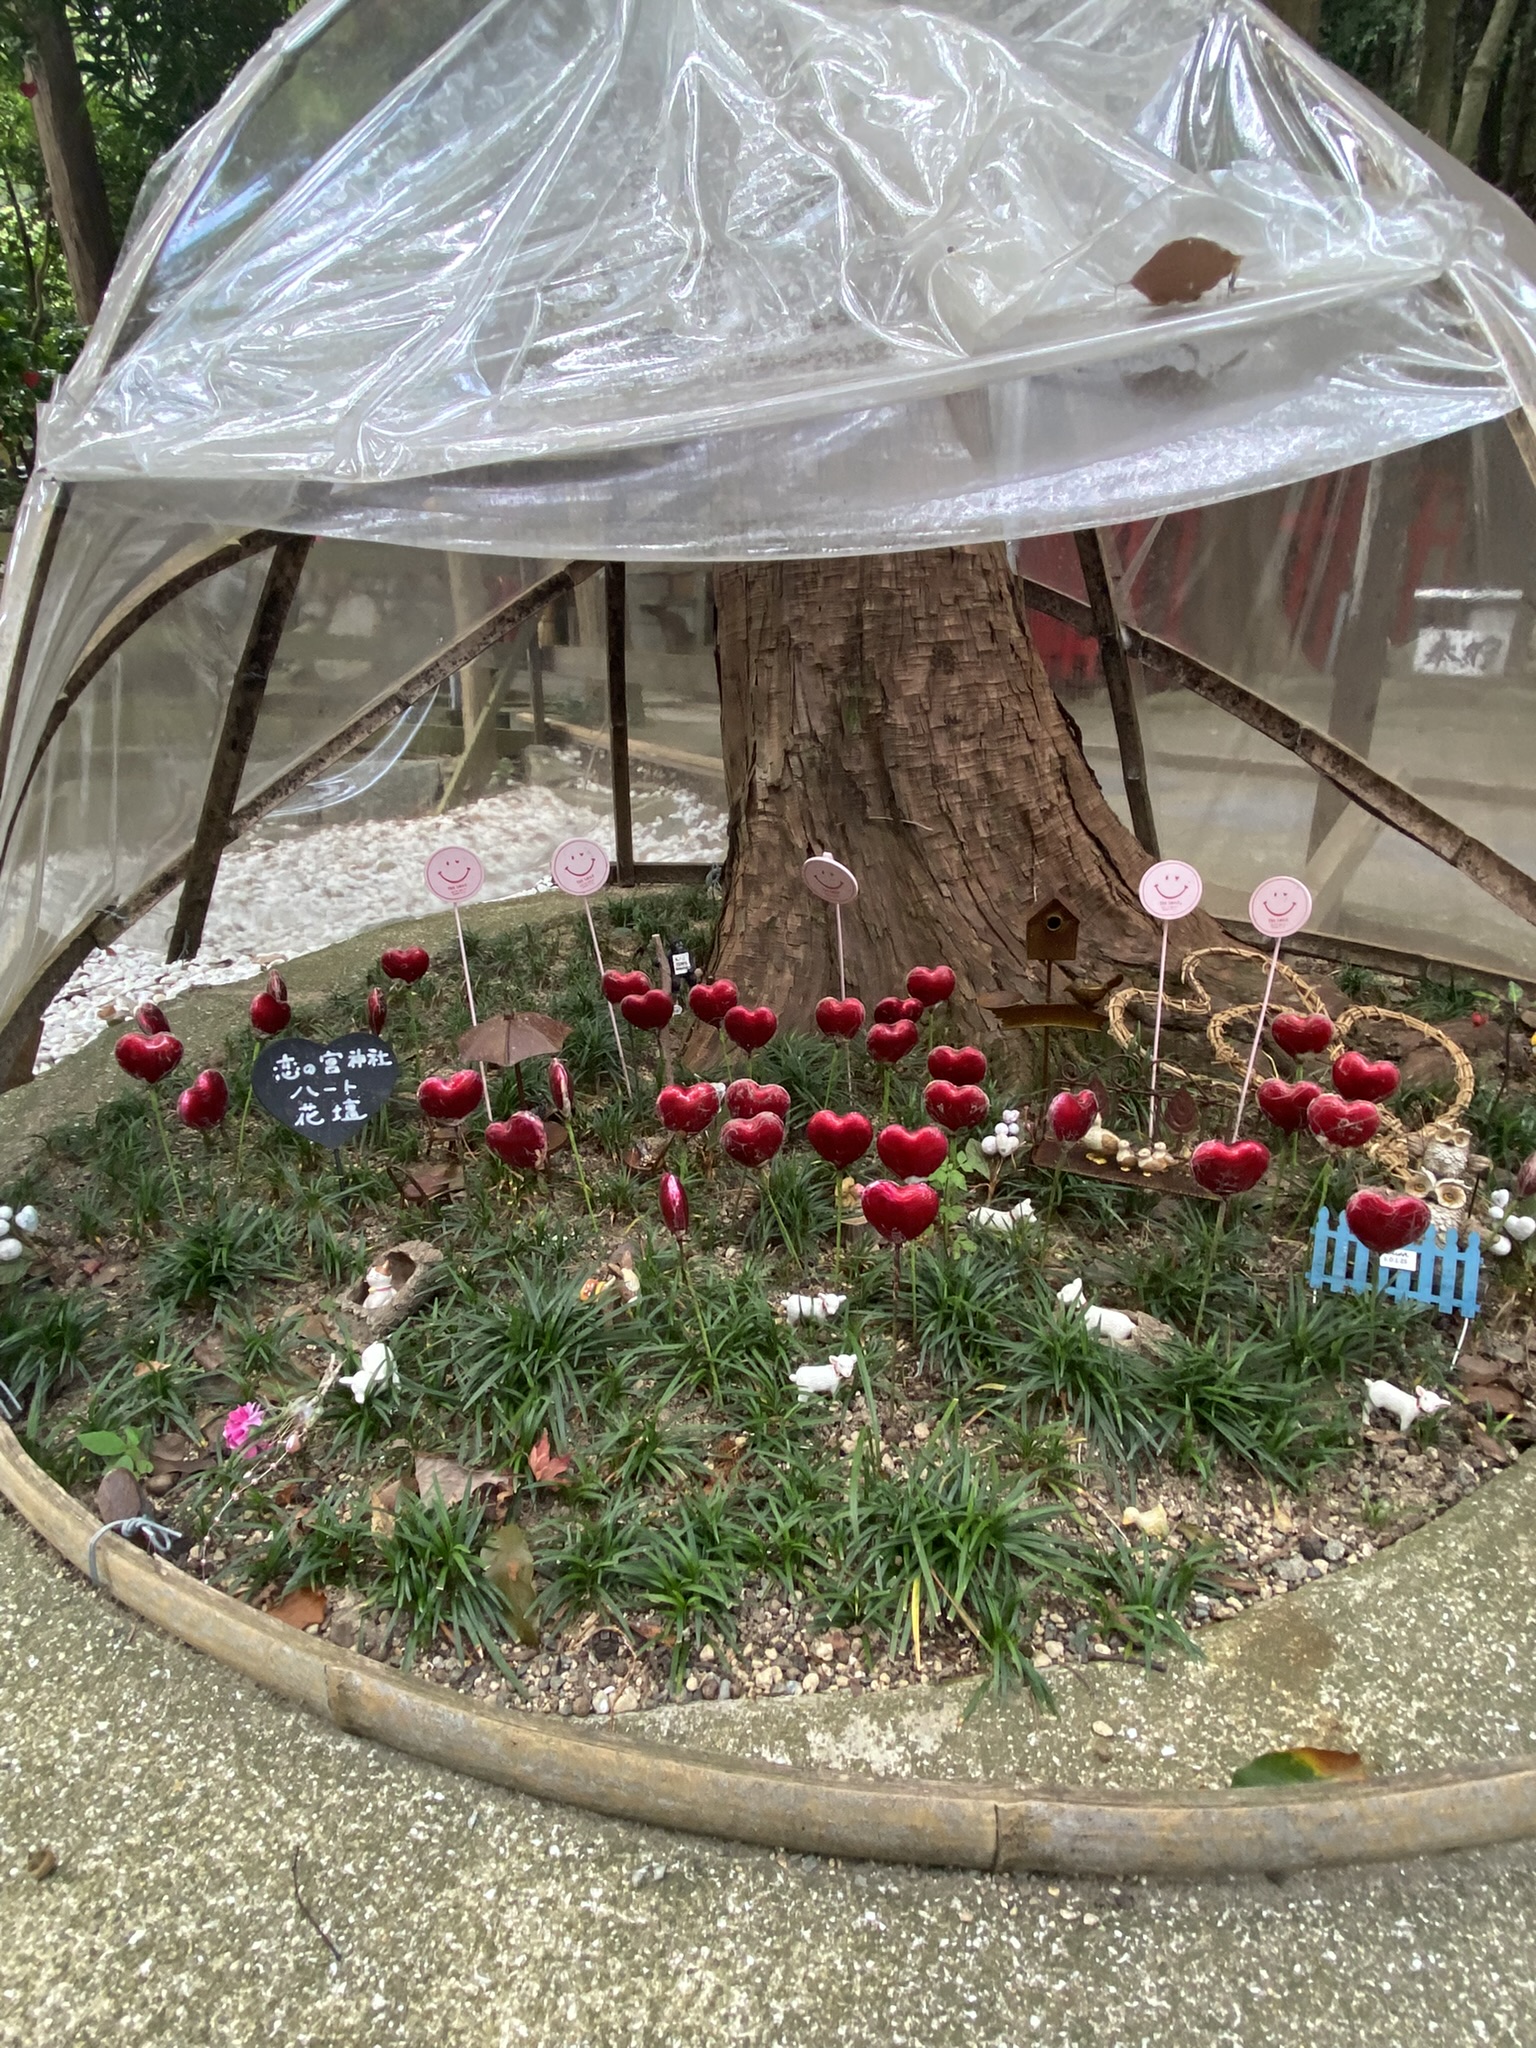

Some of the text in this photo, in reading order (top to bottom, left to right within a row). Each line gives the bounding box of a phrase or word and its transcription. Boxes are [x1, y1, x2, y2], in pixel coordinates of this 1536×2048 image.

[273, 1048, 393, 1081] 恋の宮神社
[290, 1079, 358, 1099] ハート
[295, 1098, 368, 1126] 花壇
